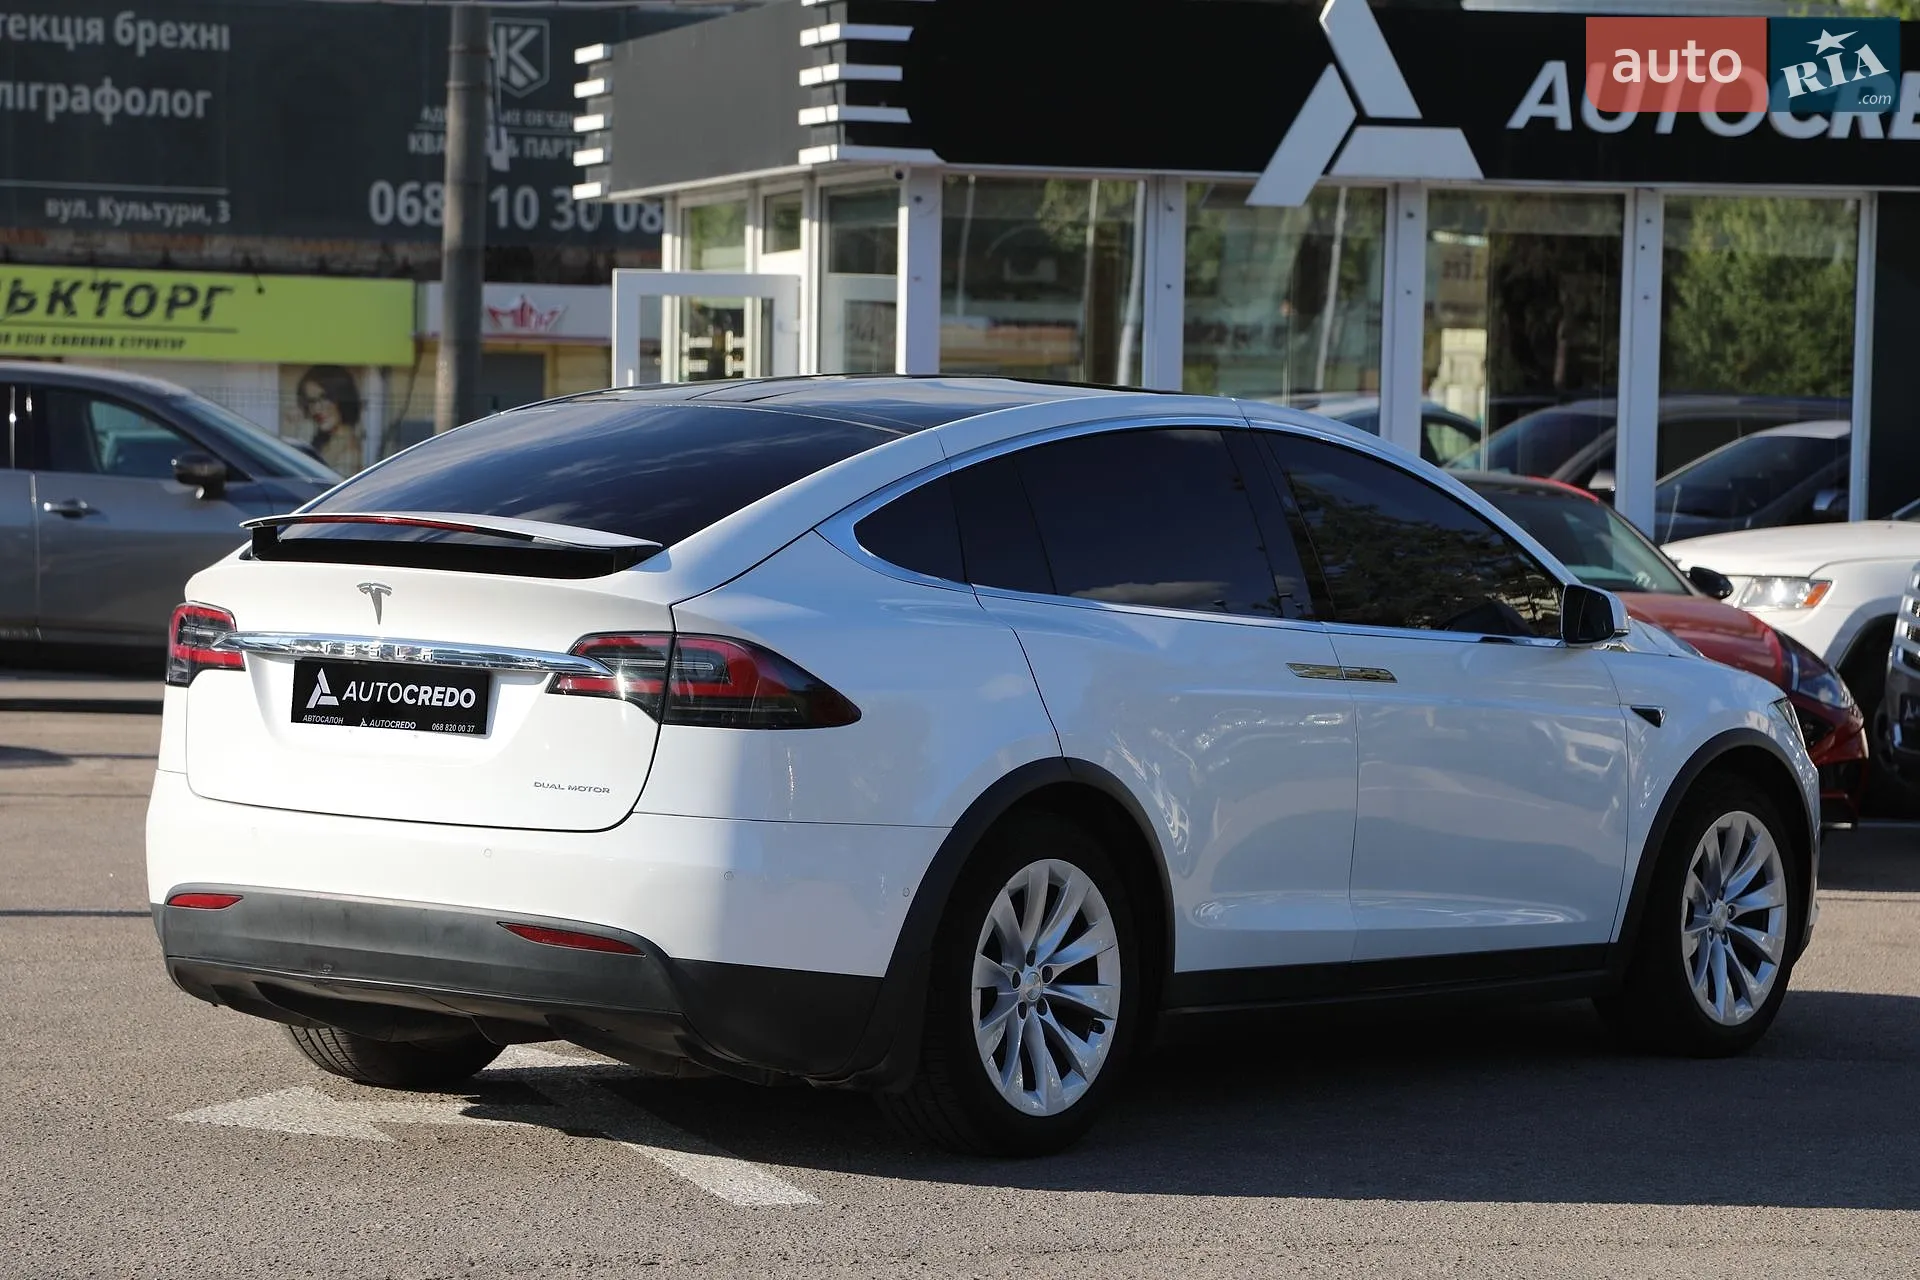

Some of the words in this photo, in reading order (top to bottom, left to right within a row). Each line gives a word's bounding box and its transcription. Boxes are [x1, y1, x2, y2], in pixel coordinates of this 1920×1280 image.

[113, 10, 231, 57] брехні
[45, 198, 93, 224] вул.
[98, 196, 212, 228] Культури,
[216, 200, 231, 224] 3
[368, 180, 444, 227] 068
[490, 184, 540, 230] 10
[0, 278, 234, 321] ЬКТОРГ
[321, 641, 433, 662] TESLA
[342, 681, 476, 708] AUTOCREDO
[302, 714, 344, 724] АВТОСАЛОН
[369, 719, 417, 730] AUTOCREDO
[431, 722, 444, 731] 068
[445, 723, 457, 732] 820
[457, 724, 466, 732] 00
[467, 724, 475, 733] 37
[534, 781, 565, 790] DUAL
[568, 785, 610, 793] MOTOR
